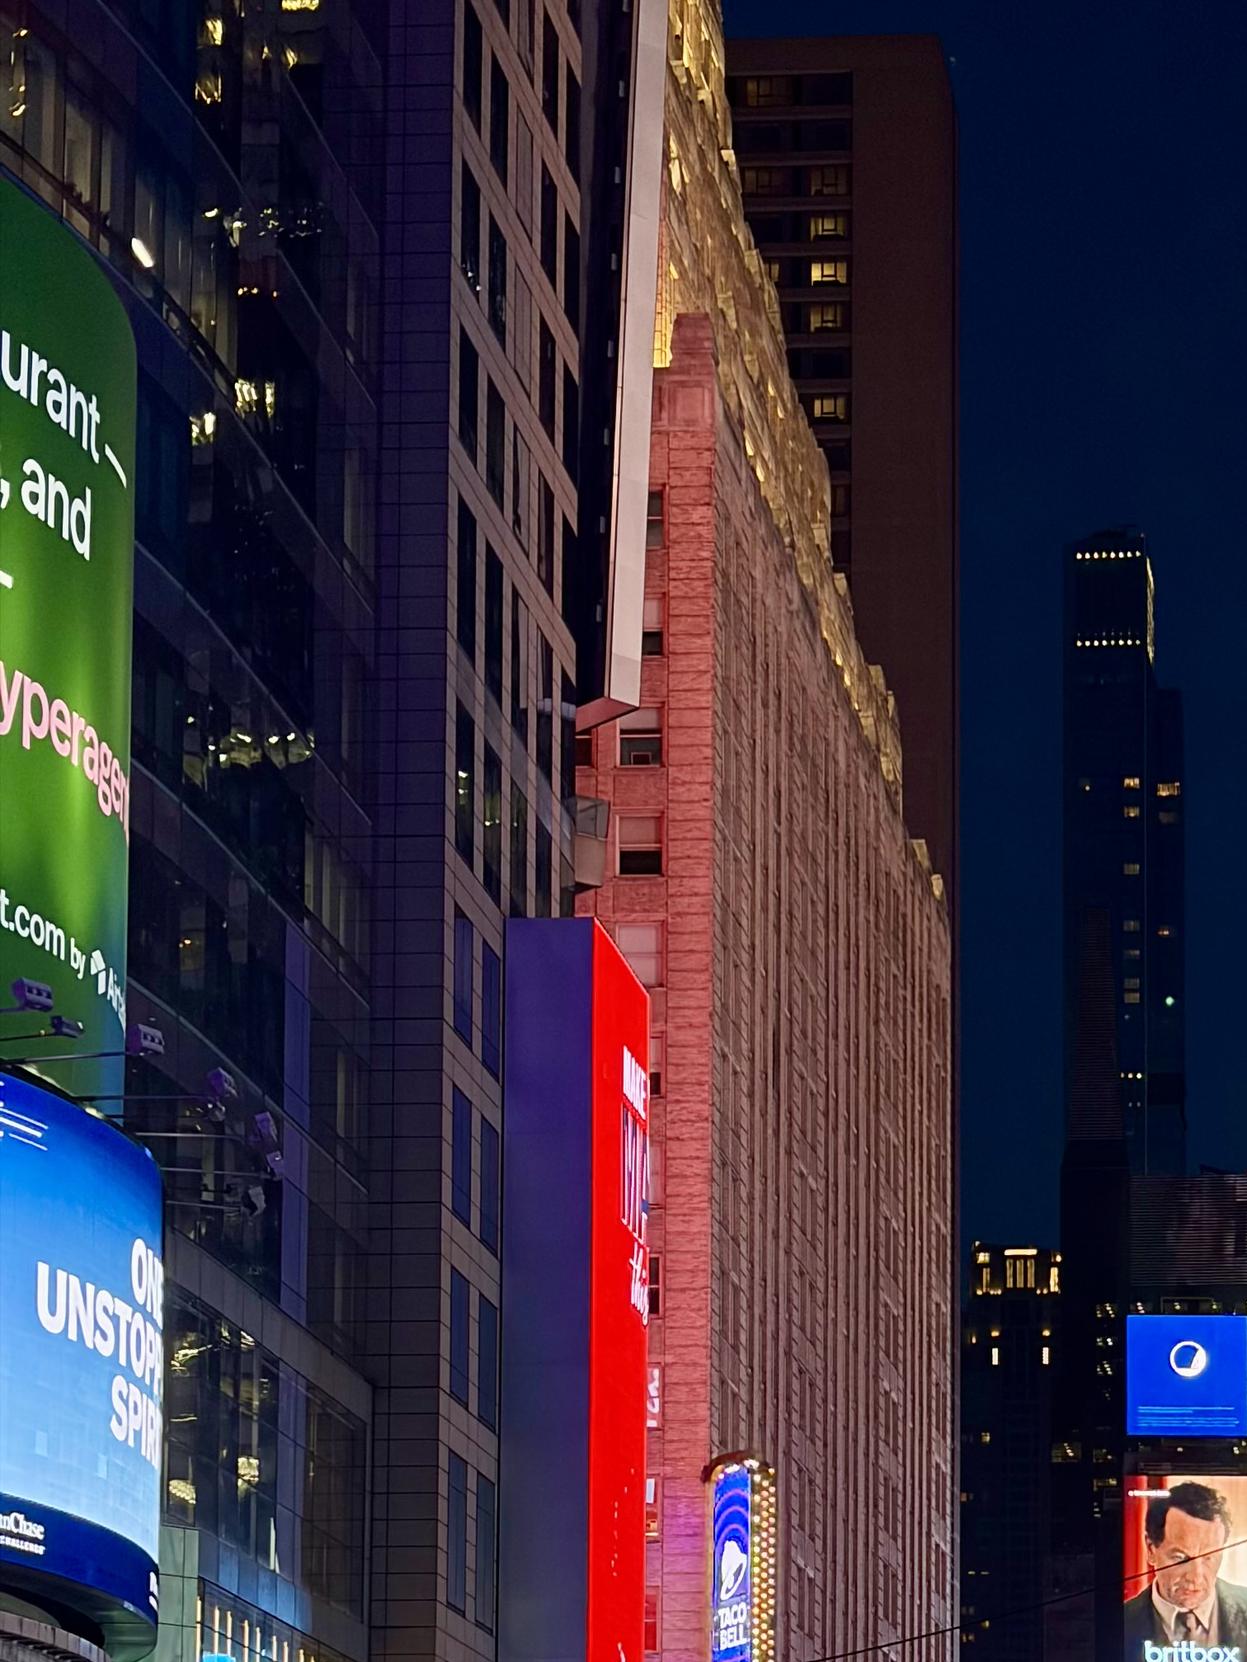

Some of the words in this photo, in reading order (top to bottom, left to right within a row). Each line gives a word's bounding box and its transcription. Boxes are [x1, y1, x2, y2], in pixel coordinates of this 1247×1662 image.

[22, 458, 91, 561] and
[70, 937, 86, 980] by
[717, 1604, 747, 1627] TACO
[719, 1625, 747, 1651] BELL
